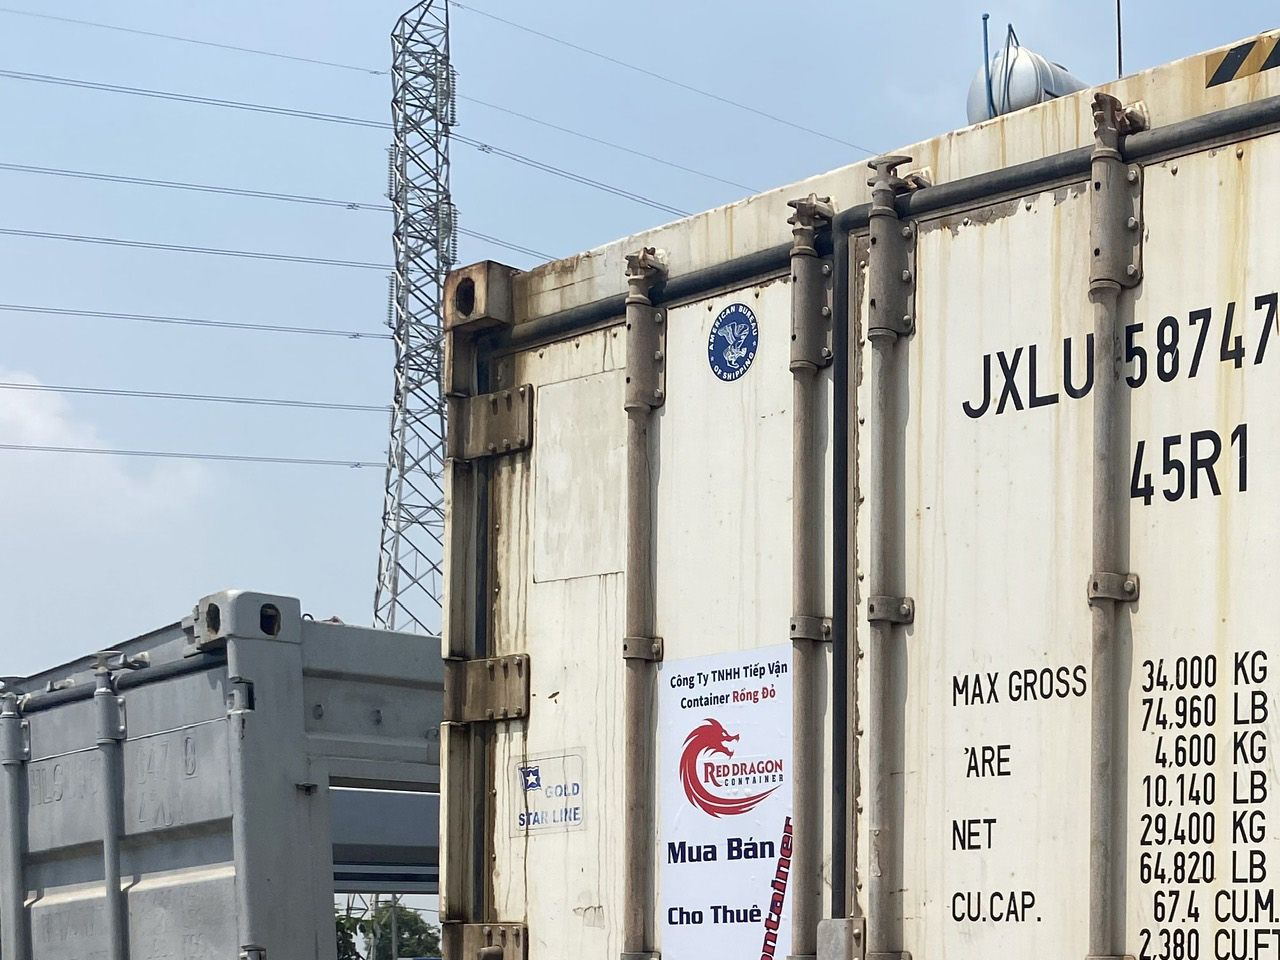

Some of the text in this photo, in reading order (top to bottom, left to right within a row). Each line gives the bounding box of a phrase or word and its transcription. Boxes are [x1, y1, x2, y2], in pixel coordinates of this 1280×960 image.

[709, 305, 758, 351] AMERICAN BUREAU
[713, 352, 755, 380] OF SHIPPING
[962, 333, 1095, 418] JXLU
[1130, 423, 1248, 506] 45R1
[670, 660, 788, 690] Công Ty TNHH Tiếp Vận
[952, 650, 1268, 706] MAX GROSS 34,000 KG
[680, 692, 731, 709] Container
[761, 683, 776, 699] Đỏ
[1141, 690, 1269, 731] 74,960 LB
[1154, 733, 1216, 768] 4,600
[1233, 730, 1267, 765] KG
[703, 759, 783, 787] RED DRAGON
[724, 774, 784, 787] CONTAINER
[1142, 770, 1268, 807] 10,140 LB
[545, 783, 580, 798] GOLD
[518, 807, 581, 827] STAR LINE
[952, 810, 1266, 850] NET 29,400 KG
[667, 836, 775, 864] Mua Bán
[1140, 849, 1267, 884] 64,820 LB
[667, 904, 762, 925] Cho Thuê
[951, 888, 1280, 923] CU.CAP. 67.4 CU.M.
[1139, 928, 1200, 960] 2,380
